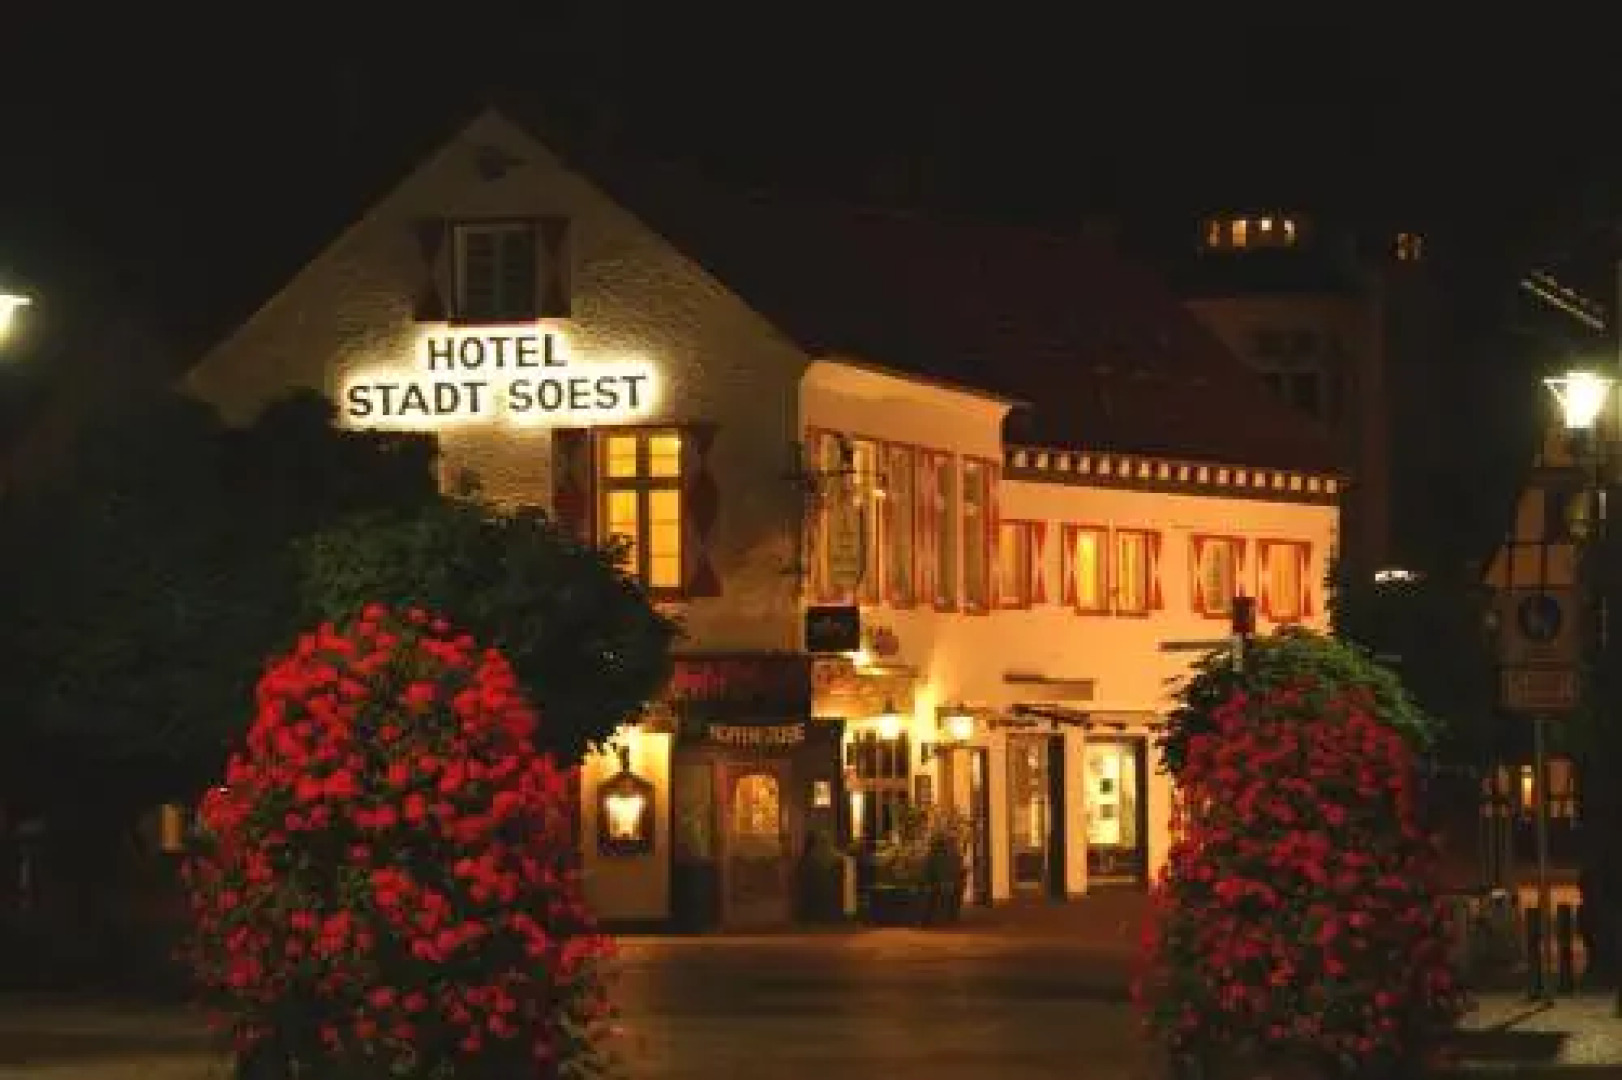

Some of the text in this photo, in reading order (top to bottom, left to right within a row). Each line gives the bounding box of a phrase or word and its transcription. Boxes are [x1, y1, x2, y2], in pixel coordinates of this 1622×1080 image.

[427, 333, 568, 370] HOTEL
[348, 375, 647, 416] STADT SOEST
